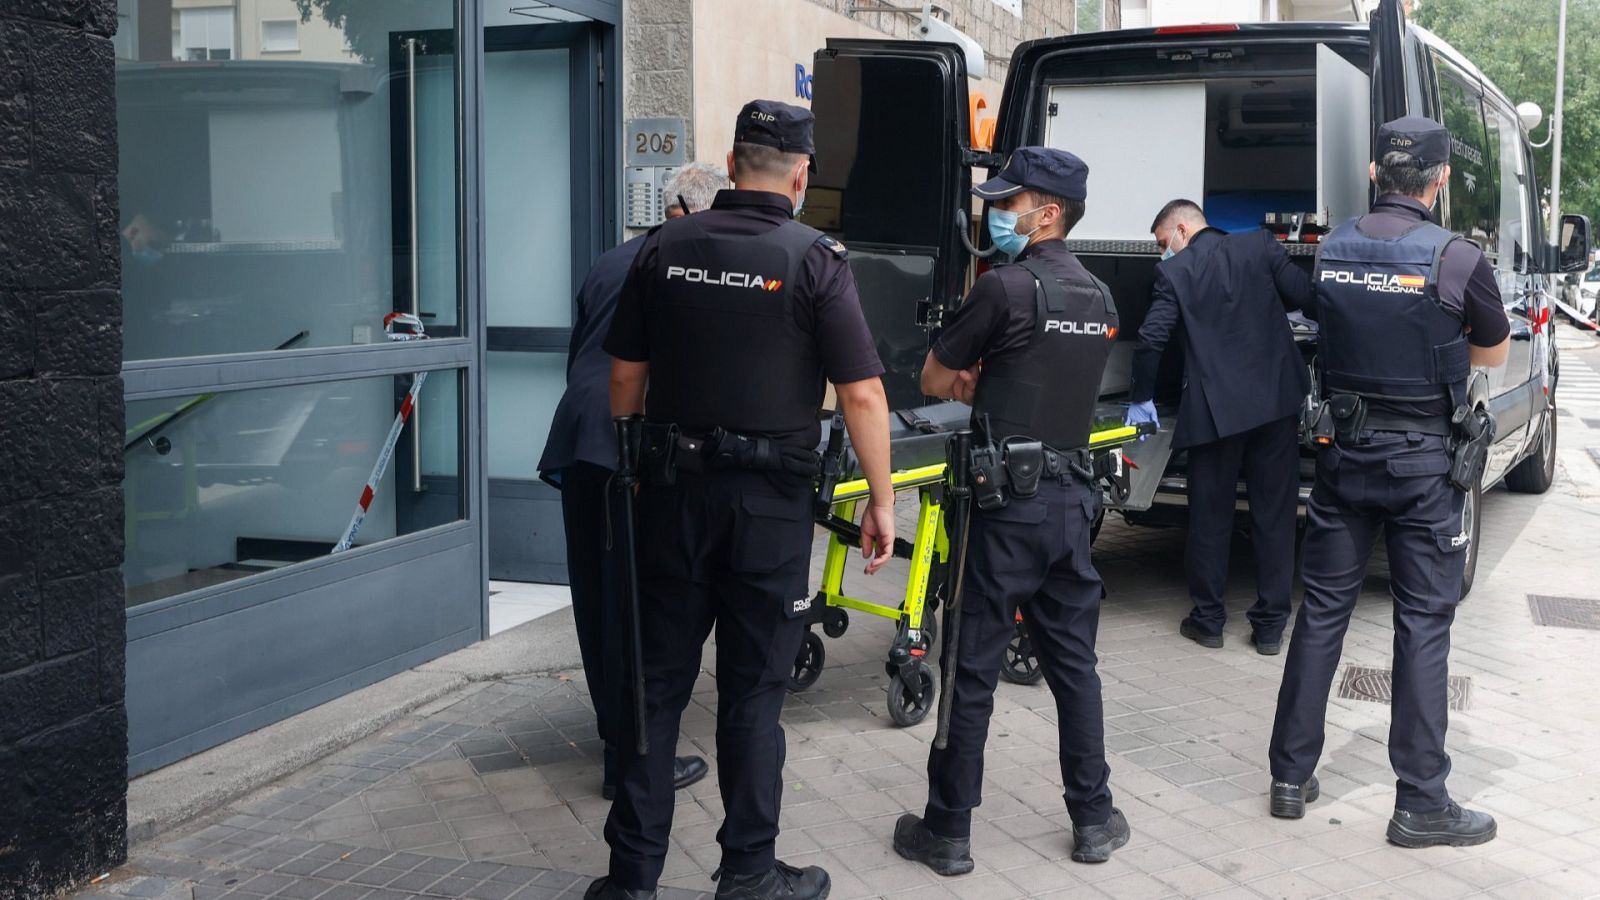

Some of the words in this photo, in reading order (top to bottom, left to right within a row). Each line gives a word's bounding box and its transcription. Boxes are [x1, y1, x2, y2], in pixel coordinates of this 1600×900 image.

[751, 111, 775, 122] CNP
[636, 132, 677, 154] 205
[1390, 137, 1412, 147] CNP
[666, 265, 766, 290] POLICIA
[1321, 270, 1400, 286] POLICIA
[1367, 284, 1424, 295] NACIONAL
[1044, 319, 1109, 338] POLICIA
